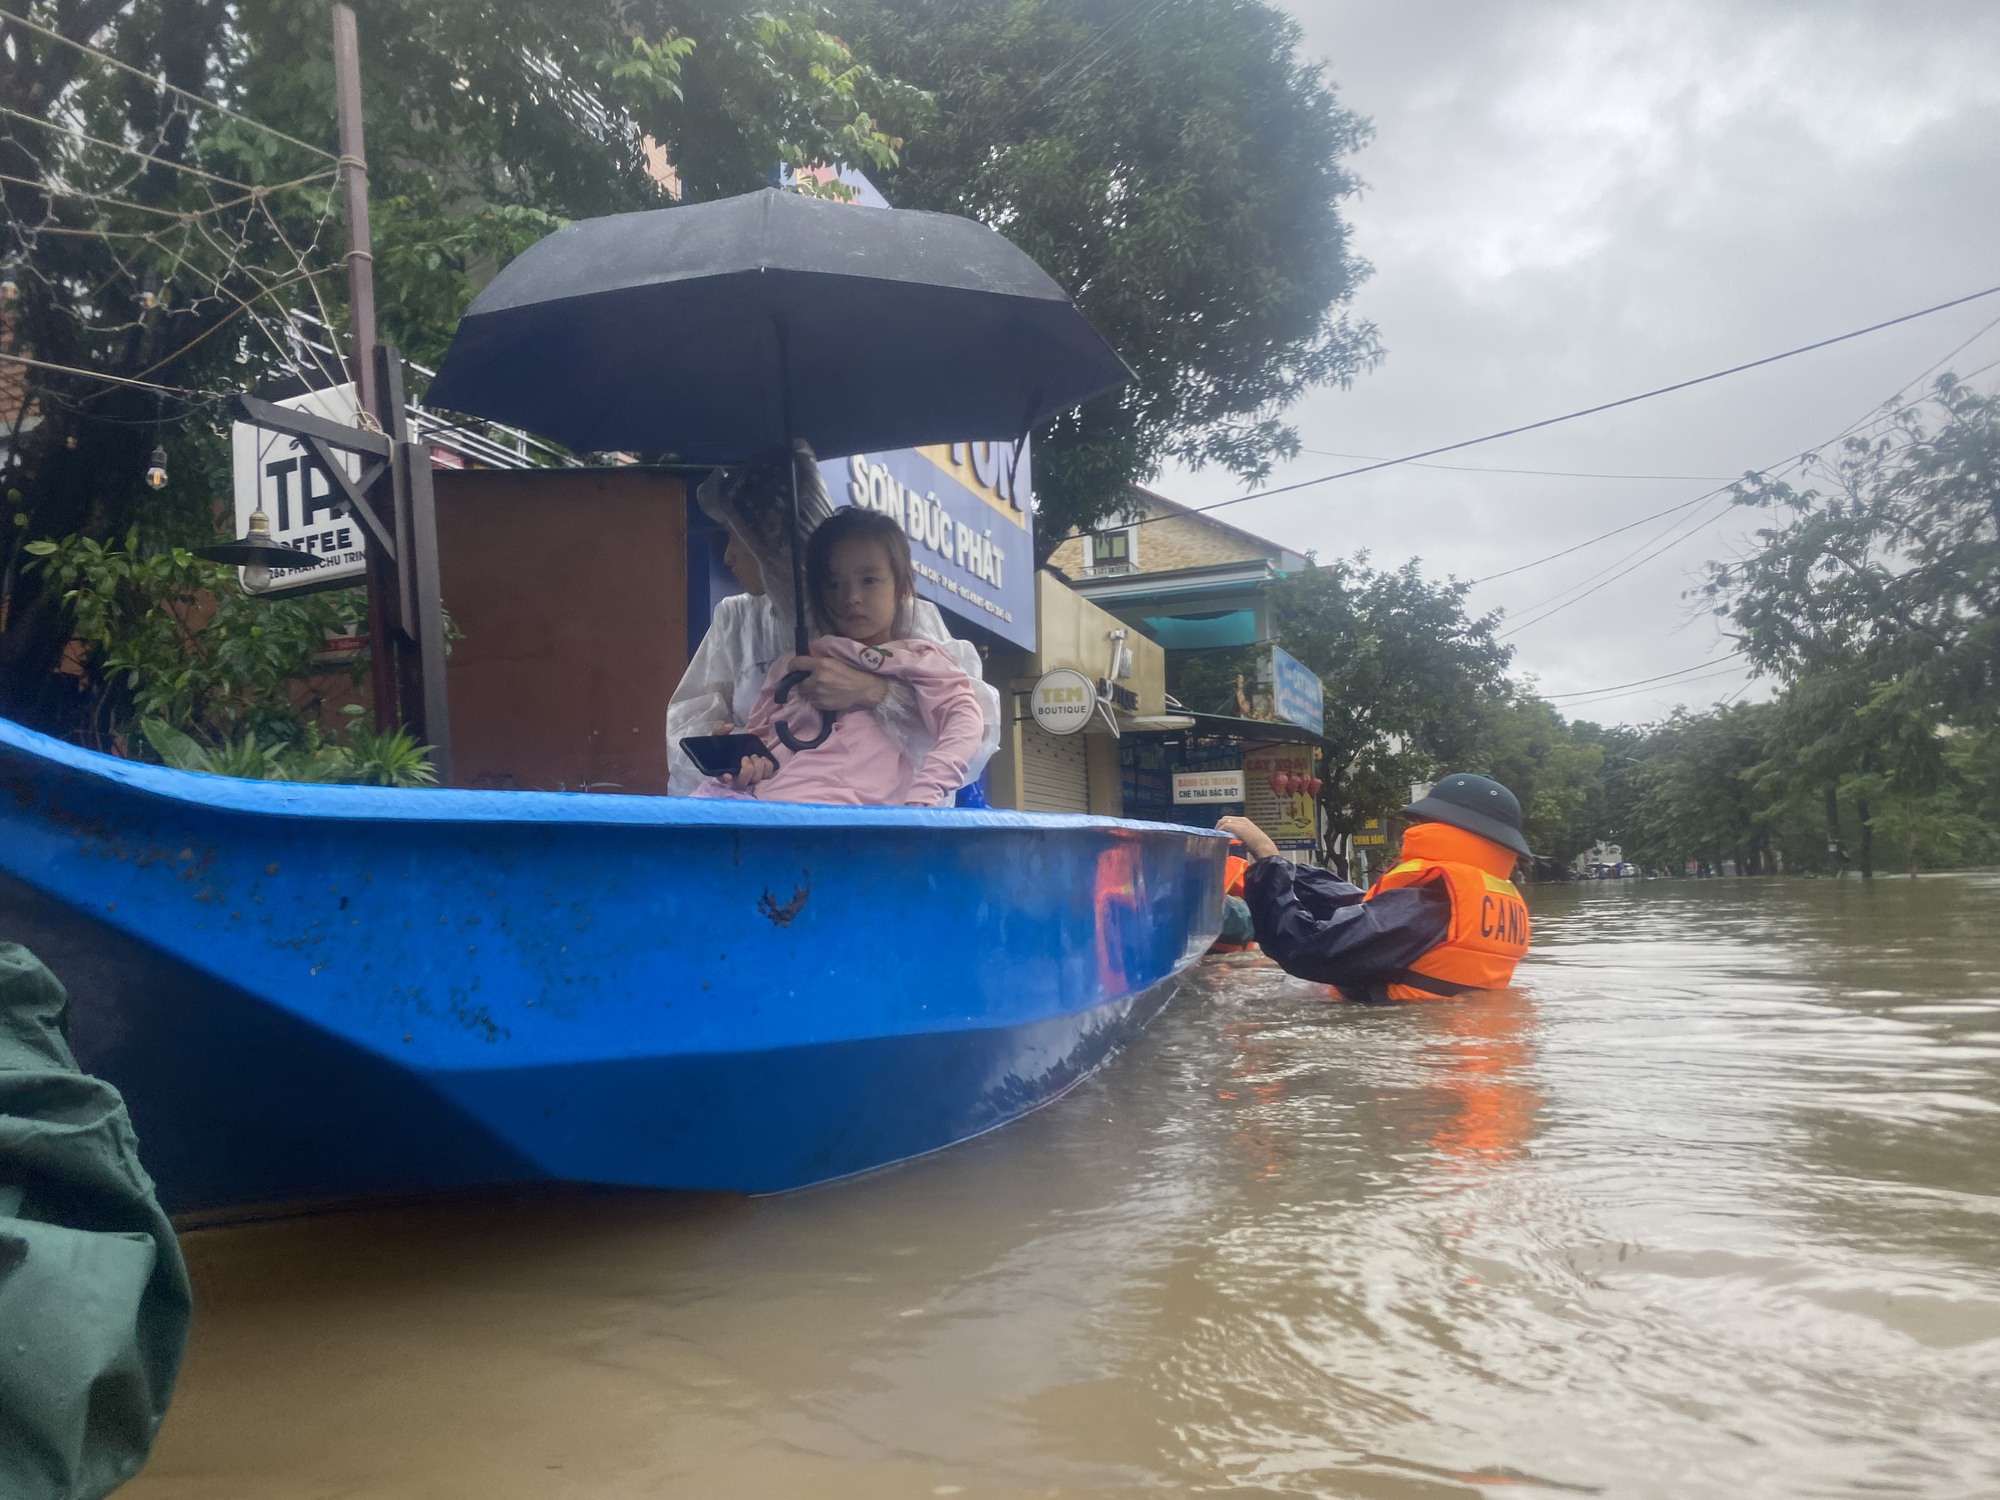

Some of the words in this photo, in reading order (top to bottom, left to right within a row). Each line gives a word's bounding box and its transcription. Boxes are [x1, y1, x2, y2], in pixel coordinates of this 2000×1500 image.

[850, 453, 904, 530] SƠN
[908, 489, 954, 559] ĐỨC
[954, 520, 1004, 589] PHÁT
[280, 528, 353, 554] FFEE
[1041, 687, 1083, 704] TEM
[1038, 705, 1086, 715] BOUTIQUE
[1193, 788, 1207, 798] THÁI
[1209, 787, 1222, 798] ĐẶC
[1224, 787, 1238, 797] BIỆT
[1481, 895, 1526, 946] CAND
